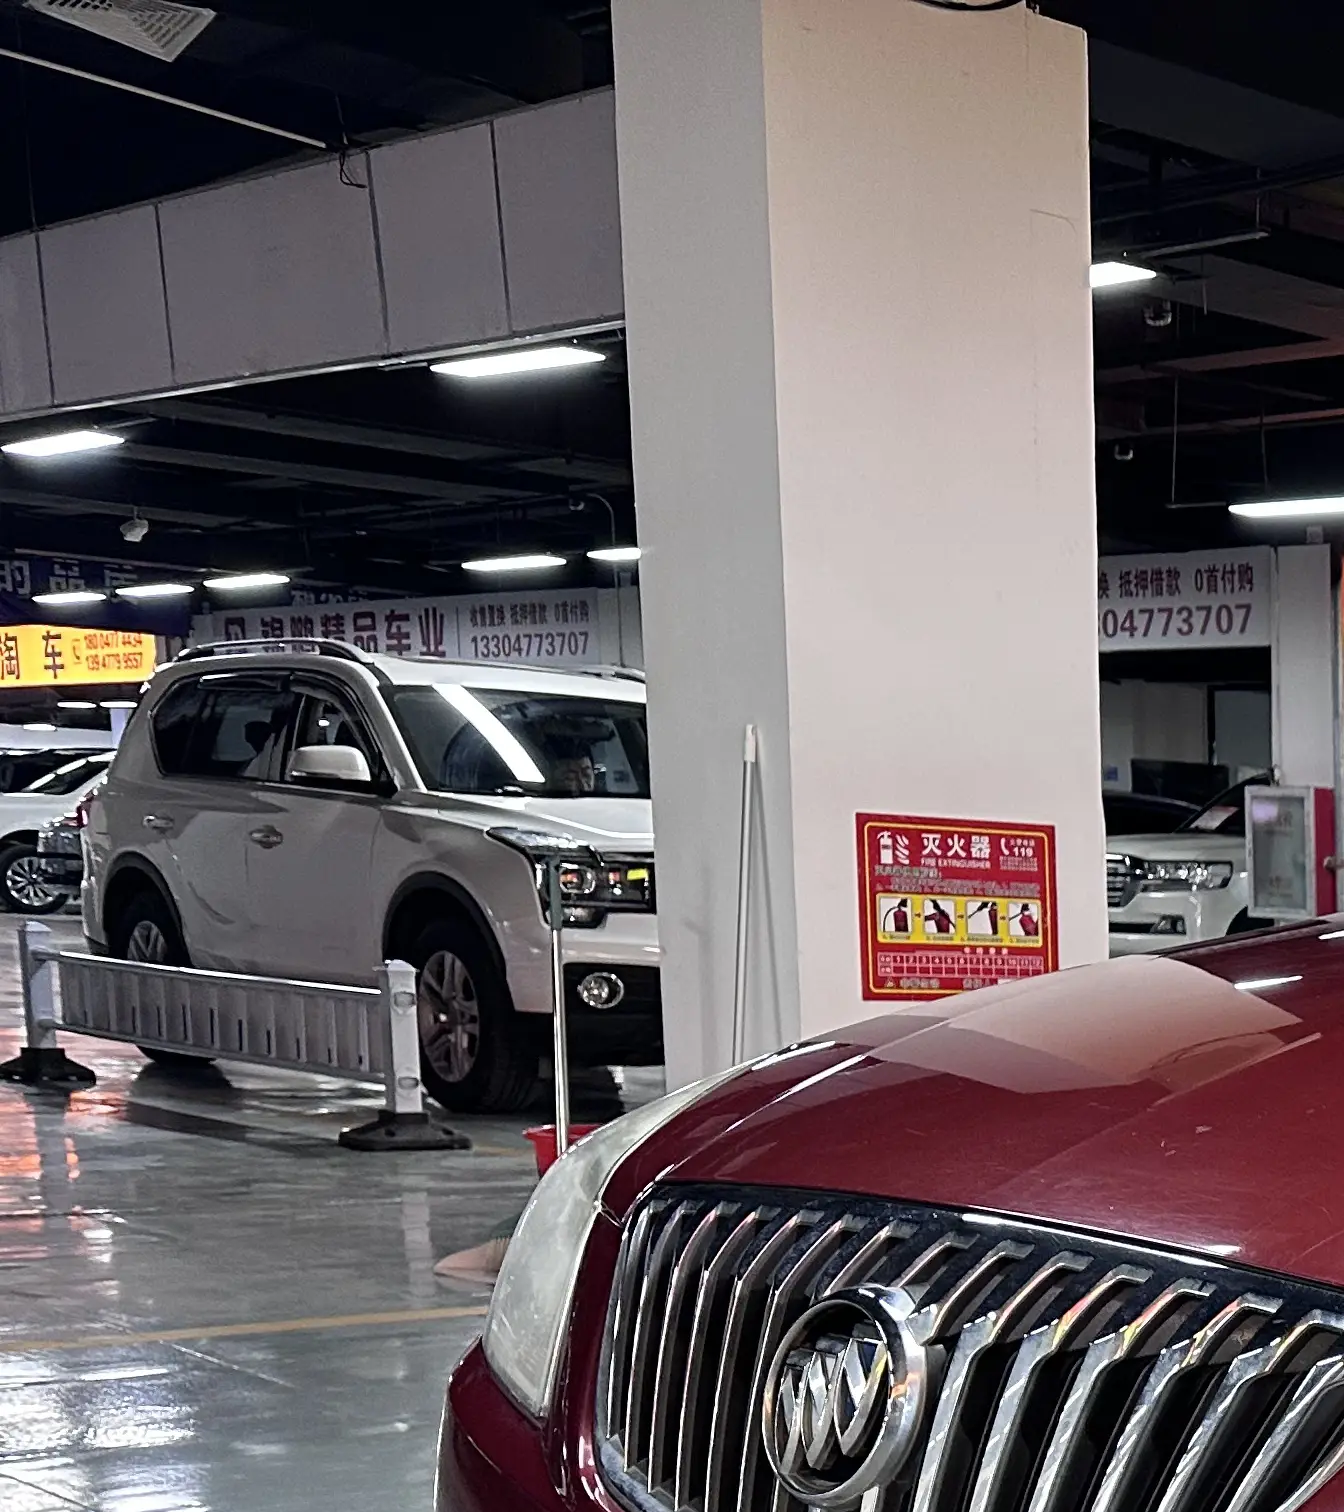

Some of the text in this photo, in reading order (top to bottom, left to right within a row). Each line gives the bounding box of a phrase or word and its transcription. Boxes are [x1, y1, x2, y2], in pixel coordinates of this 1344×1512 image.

[1118, 565, 1182, 599] 抵押借款
[1194, 562, 1254, 595] 0首付购
[1098, 602, 1253, 639] 04773707
[470, 630, 590, 659] 13304773707
[920, 832, 991, 859] 灭火器
[1012, 846, 1034, 858] 119
